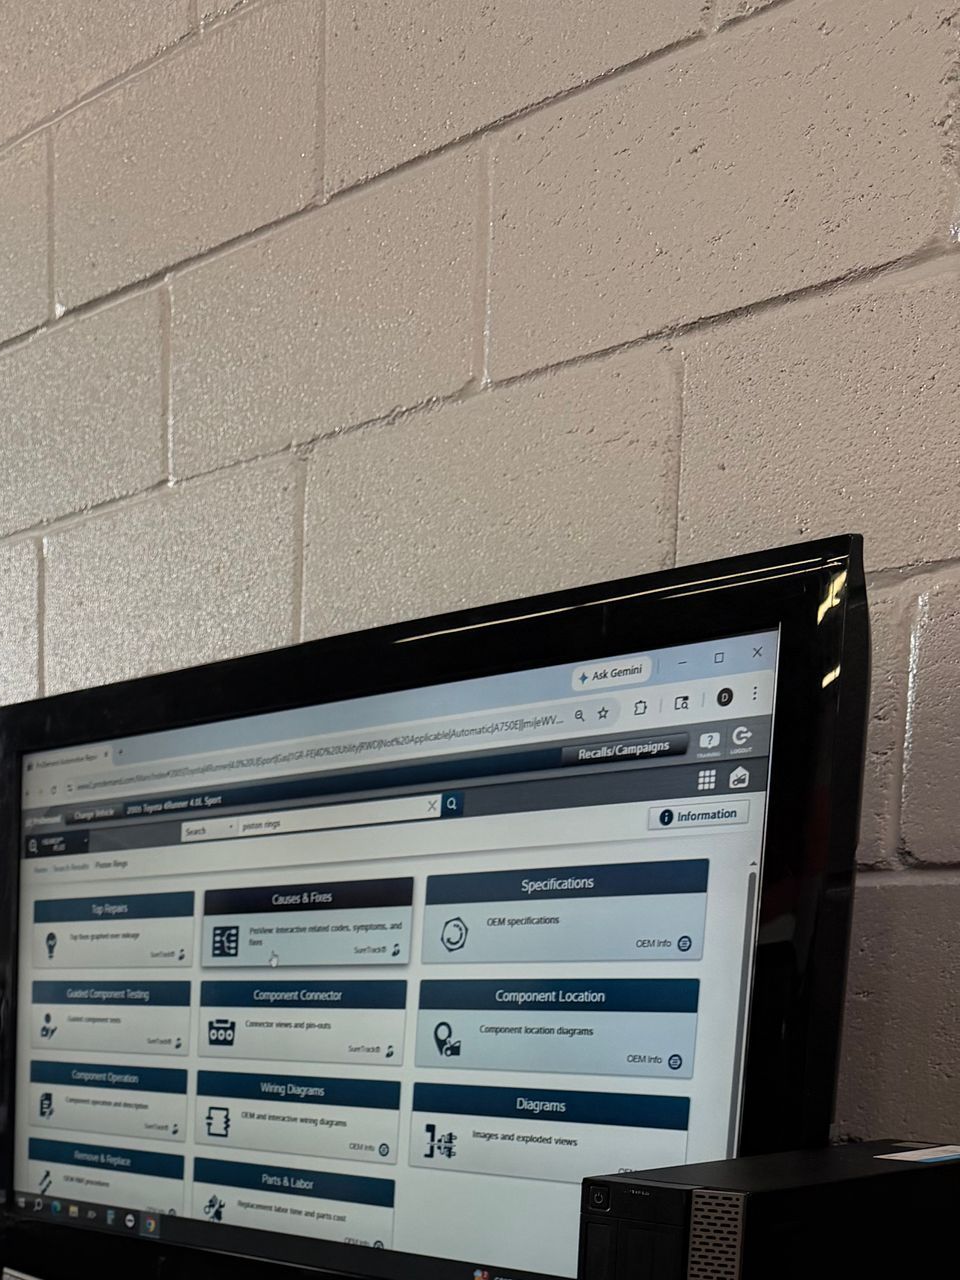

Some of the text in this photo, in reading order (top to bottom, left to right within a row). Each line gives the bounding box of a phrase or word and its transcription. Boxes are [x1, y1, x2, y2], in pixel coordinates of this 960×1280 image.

[592, 665, 642, 681] Ask Gemini
[578, 741, 670, 760] Recalls/Campaigns
[677, 808, 737, 822] Information
[521, 877, 594, 892] Specifications
[272, 892, 333, 905] Causes & Fixes
[91, 904, 128, 916] Top Repairs
[390, 922, 403, 931] and
[487, 915, 560, 927] OEM specifications
[636, 938, 655, 948] OEM
[89, 989, 126, 1001] Component
[126, 989, 150, 1002] Testing
[253, 989, 343, 1002] Component Connector
[495, 989, 606, 1004] Component Location
[245, 1020, 274, 1029] Connector
[293, 1021, 305, 1029] and
[479, 1025, 594, 1038] Component location diagrams
[627, 1054, 647, 1063] OEM
[72, 1069, 139, 1085] Component Operation
[260, 1081, 326, 1098] Wiring Diagrams
[516, 1097, 566, 1114] Diagrams
[256, 1112, 267, 1121] and
[268, 1113, 299, 1124] interactive
[299, 1116, 319, 1127] wiring
[319, 1117, 348, 1128] diagrams
[472, 1130, 578, 1147] Images and exploded views
[261, 1174, 314, 1190] Parts & Labor
[304, 1208, 315, 1218] and
[315, 1211, 332, 1221] parts
